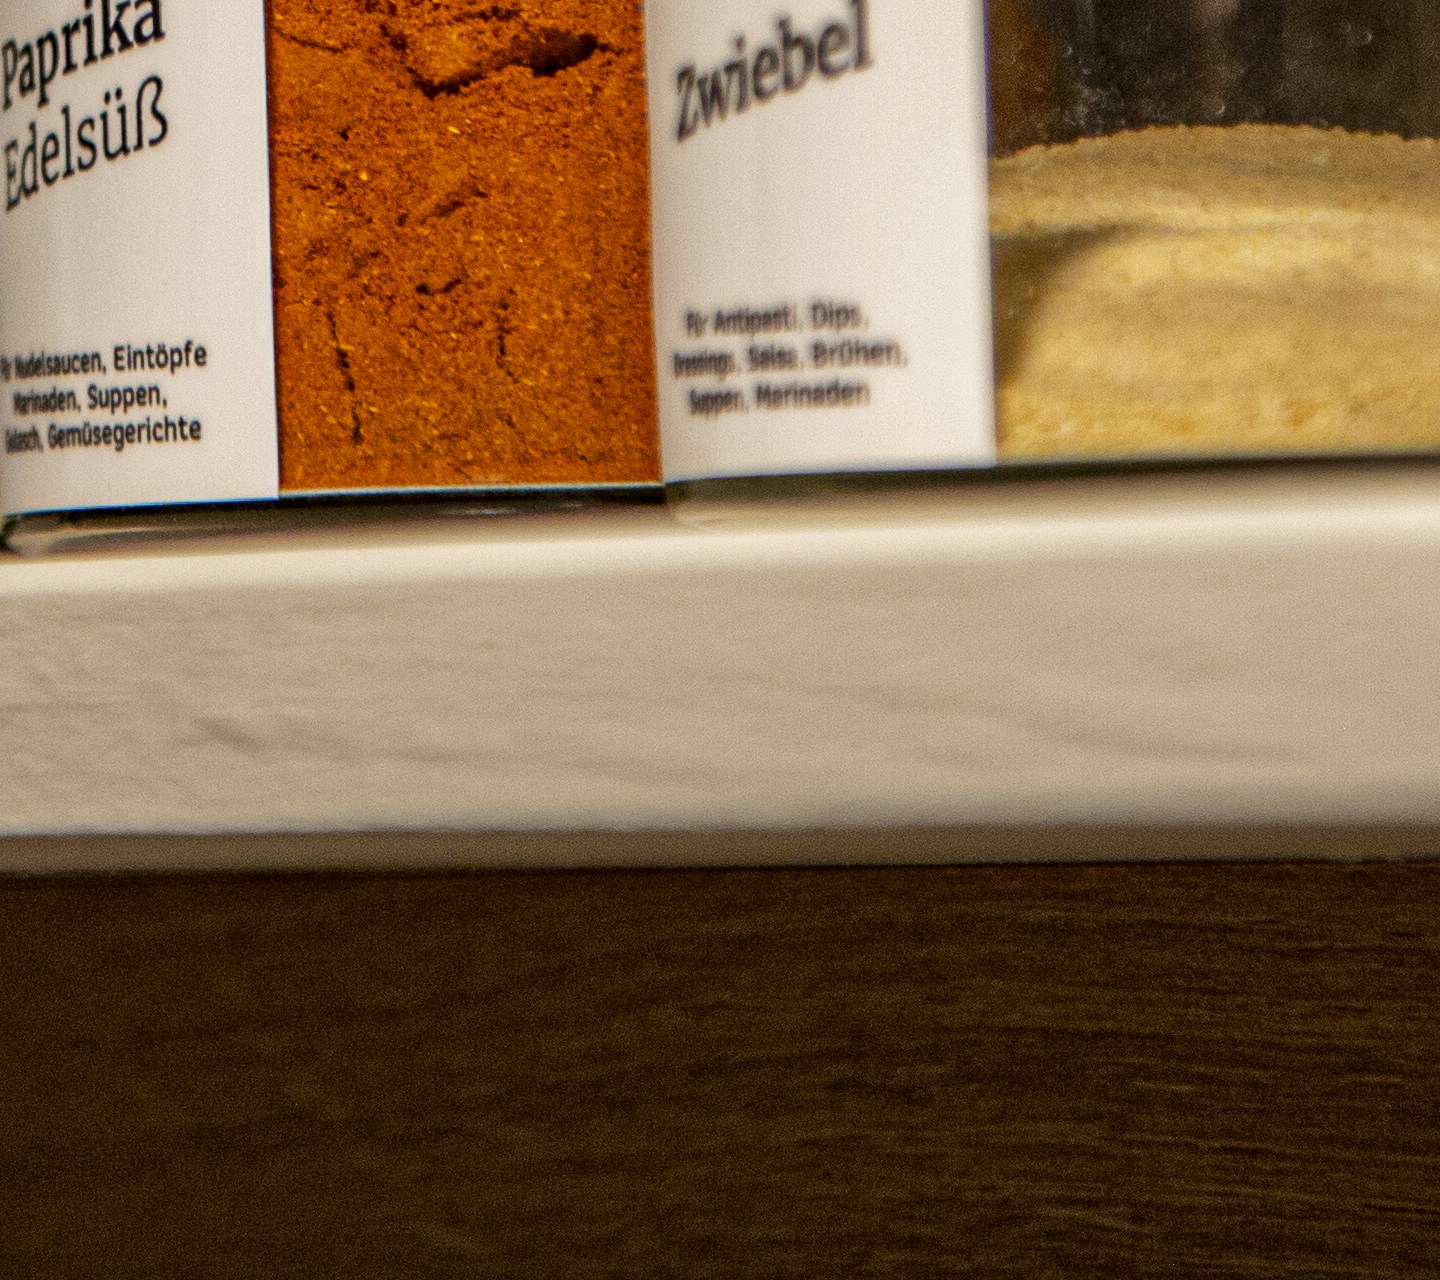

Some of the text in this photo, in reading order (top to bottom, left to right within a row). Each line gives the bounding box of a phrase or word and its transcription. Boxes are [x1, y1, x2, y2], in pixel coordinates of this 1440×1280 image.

[4, 74, 169, 213] Edelsüß
[113, 339, 209, 376] Eintöpfe
[87, 382, 168, 415] Suppen,
[47, 415, 203, 453] Gemüsegerichte
